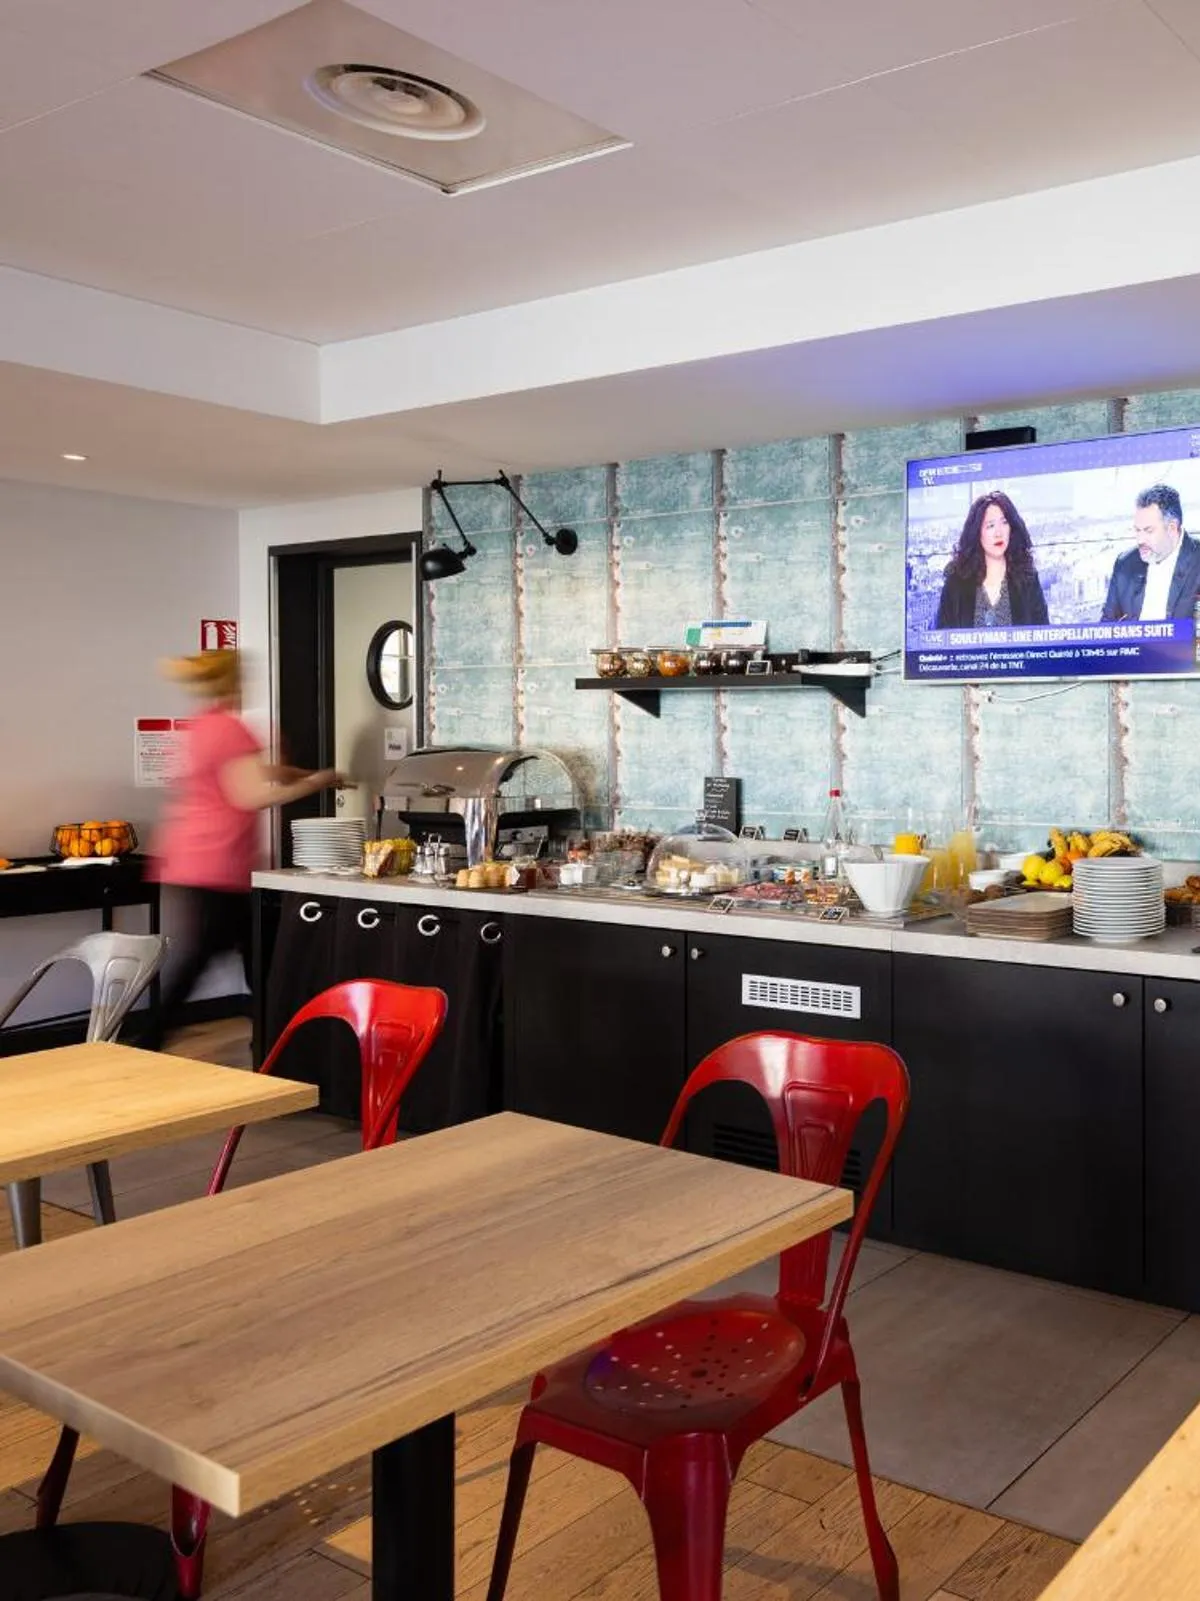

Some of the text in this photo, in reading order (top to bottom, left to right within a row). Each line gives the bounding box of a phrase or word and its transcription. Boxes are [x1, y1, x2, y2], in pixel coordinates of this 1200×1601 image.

[950, 631, 1007, 645] SOULEYMAN
[1013, 630, 1032, 642] UNE
[1032, 626, 1112, 641] INTERPELLATION
[1113, 625, 1142, 639] SANS
[1144, 623, 1174, 638] SUITE
[1026, 650, 1047, 659] Direct
[1106, 649, 1118, 657] sur
